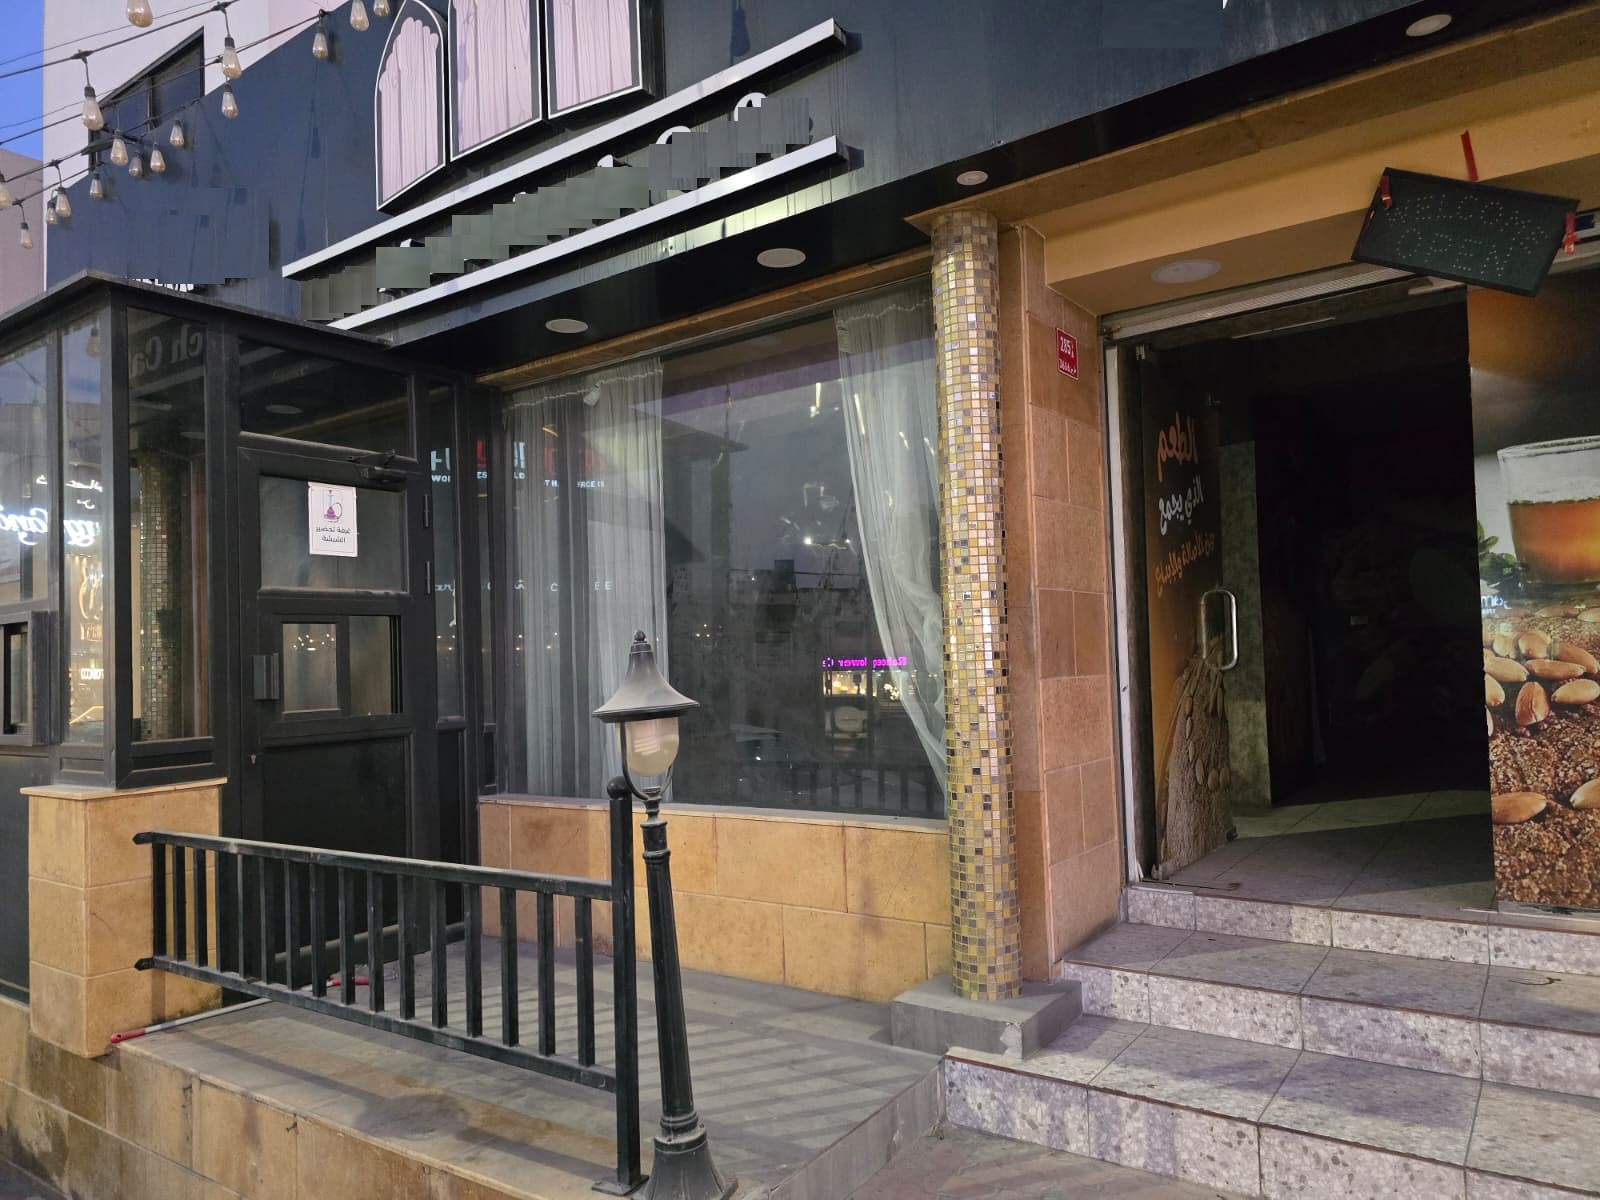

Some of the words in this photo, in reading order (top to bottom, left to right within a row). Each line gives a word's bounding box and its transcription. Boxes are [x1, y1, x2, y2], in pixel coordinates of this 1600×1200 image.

[1395, 228, 1514, 281] OPEN
[1157, 411, 1199, 482] الطعم
[1159, 492, 1185, 537] يجمع
[1184, 473, 1205, 526] الذي
